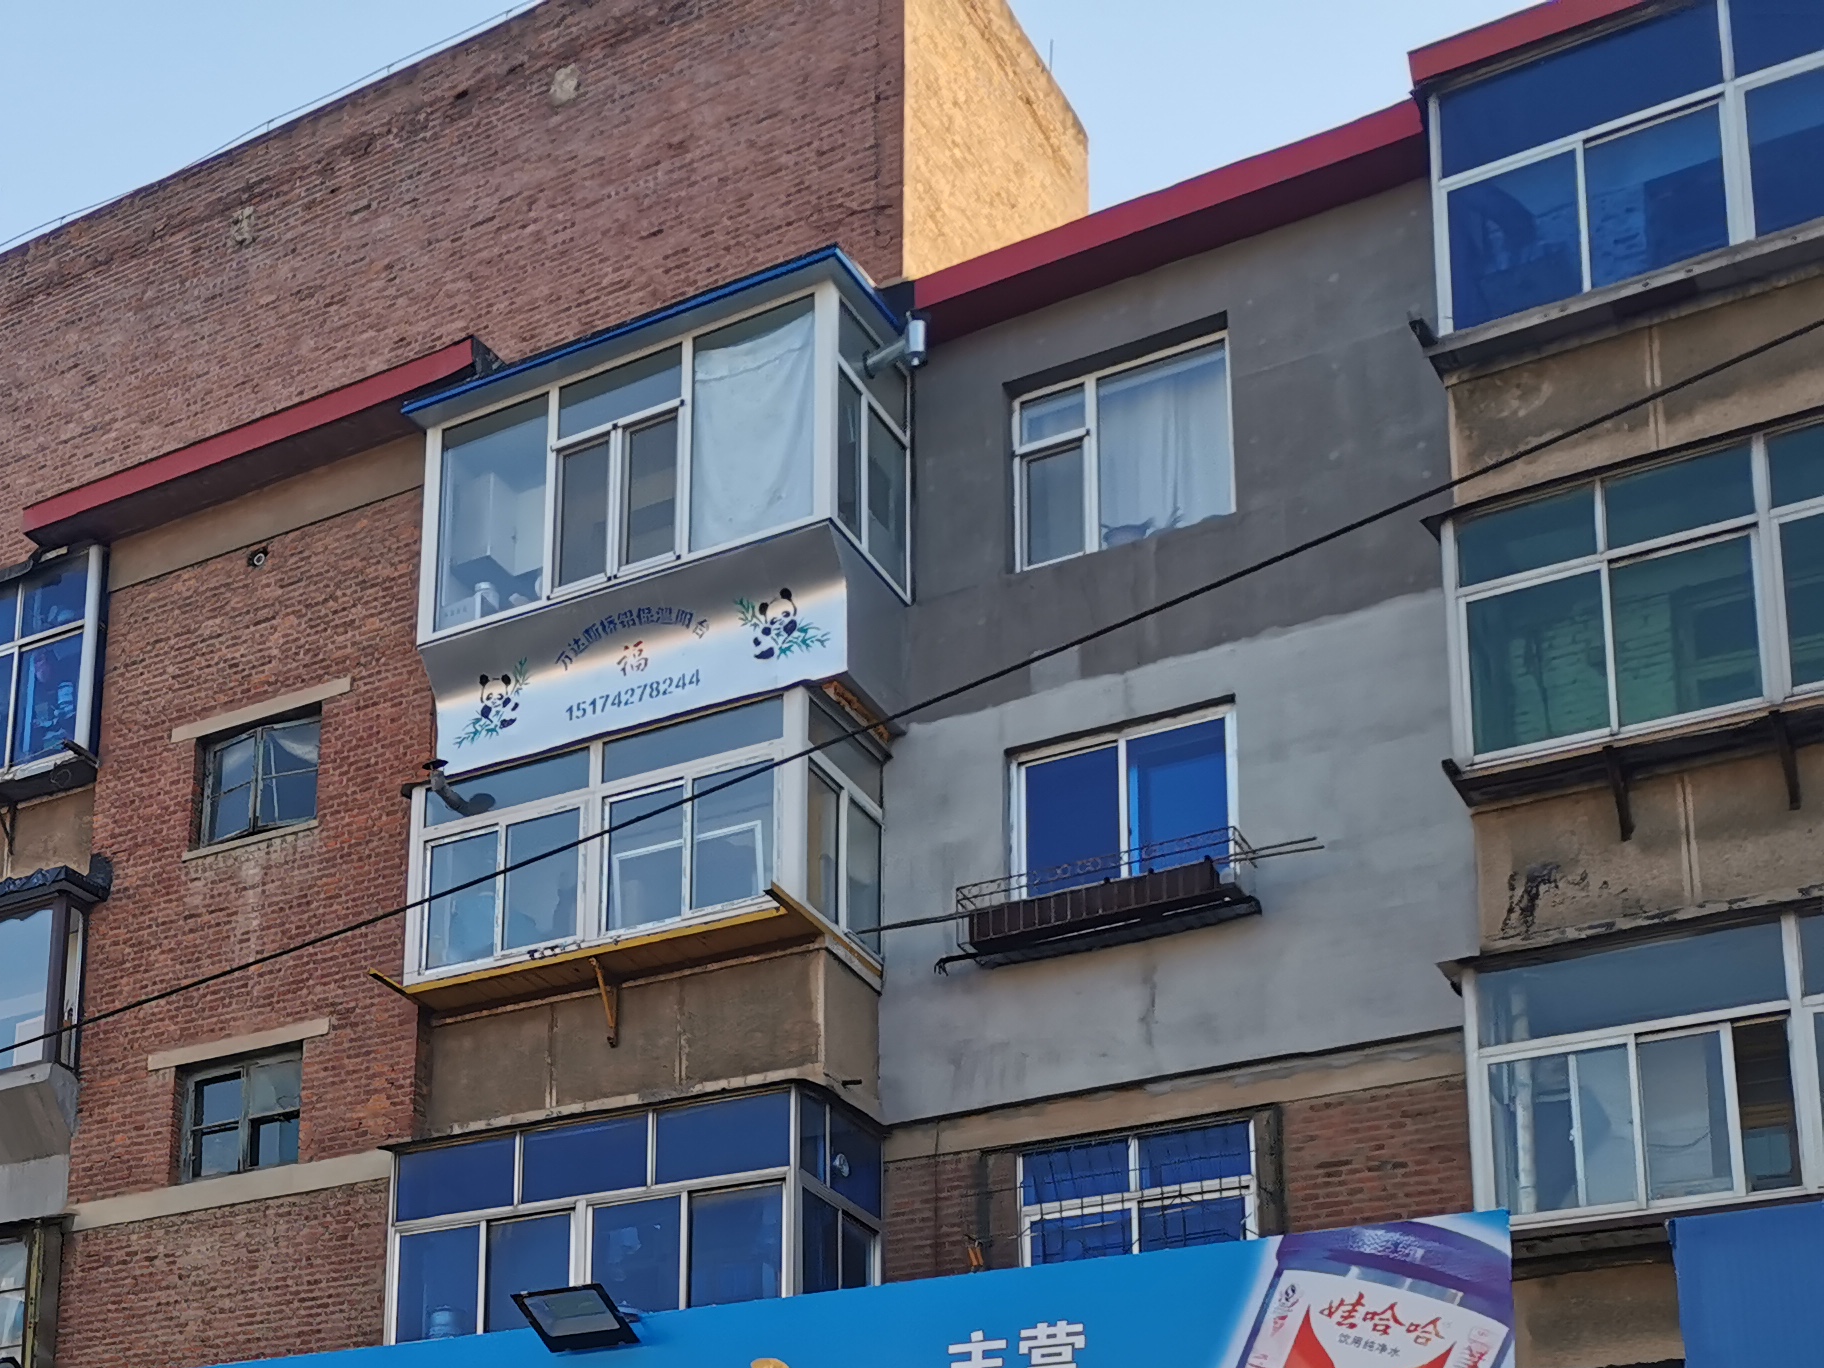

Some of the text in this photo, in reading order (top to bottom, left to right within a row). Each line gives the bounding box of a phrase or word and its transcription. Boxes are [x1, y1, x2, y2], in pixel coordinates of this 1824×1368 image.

[616, 640, 649, 677] 福
[565, 668, 701, 722] 15174278244
[1319, 1291, 1445, 1346] 娃哈哈
[1337, 1332, 1401, 1358] 饮用纯净水
